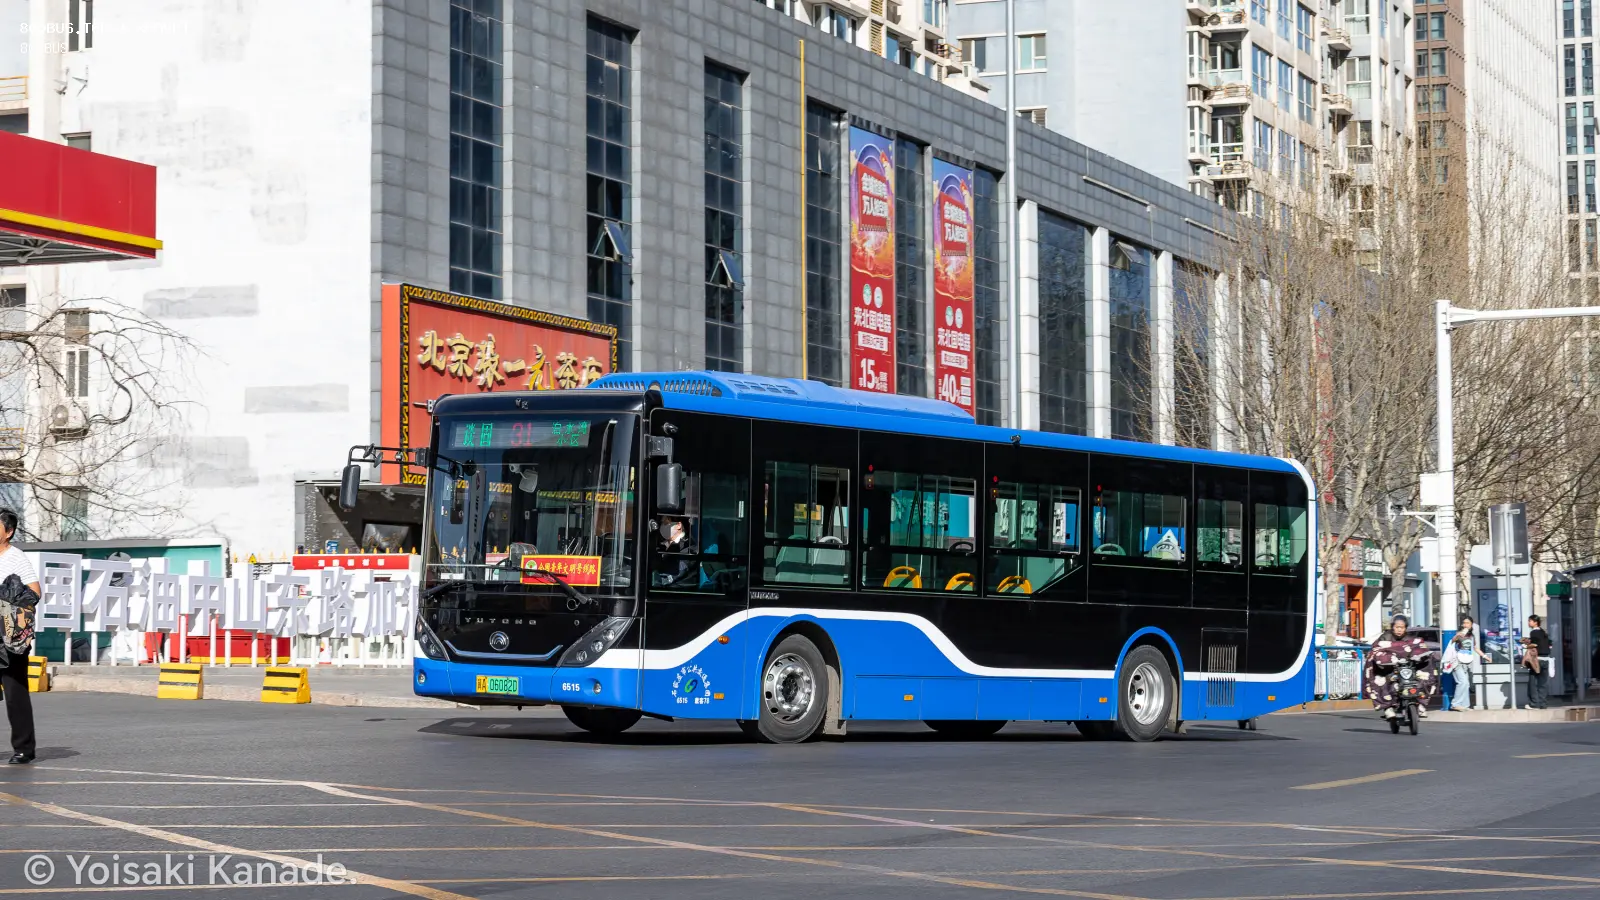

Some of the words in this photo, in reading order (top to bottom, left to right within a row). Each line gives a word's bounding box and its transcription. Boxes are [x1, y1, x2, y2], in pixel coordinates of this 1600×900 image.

[854, 306, 891, 333] 来北国电器
[937, 328, 971, 351] 来北国电器
[511, 422, 533, 447] 31
[556, 433, 580, 448] 小区
[465, 617, 537, 625] YUTONG
[562, 682, 580, 692] 6515
